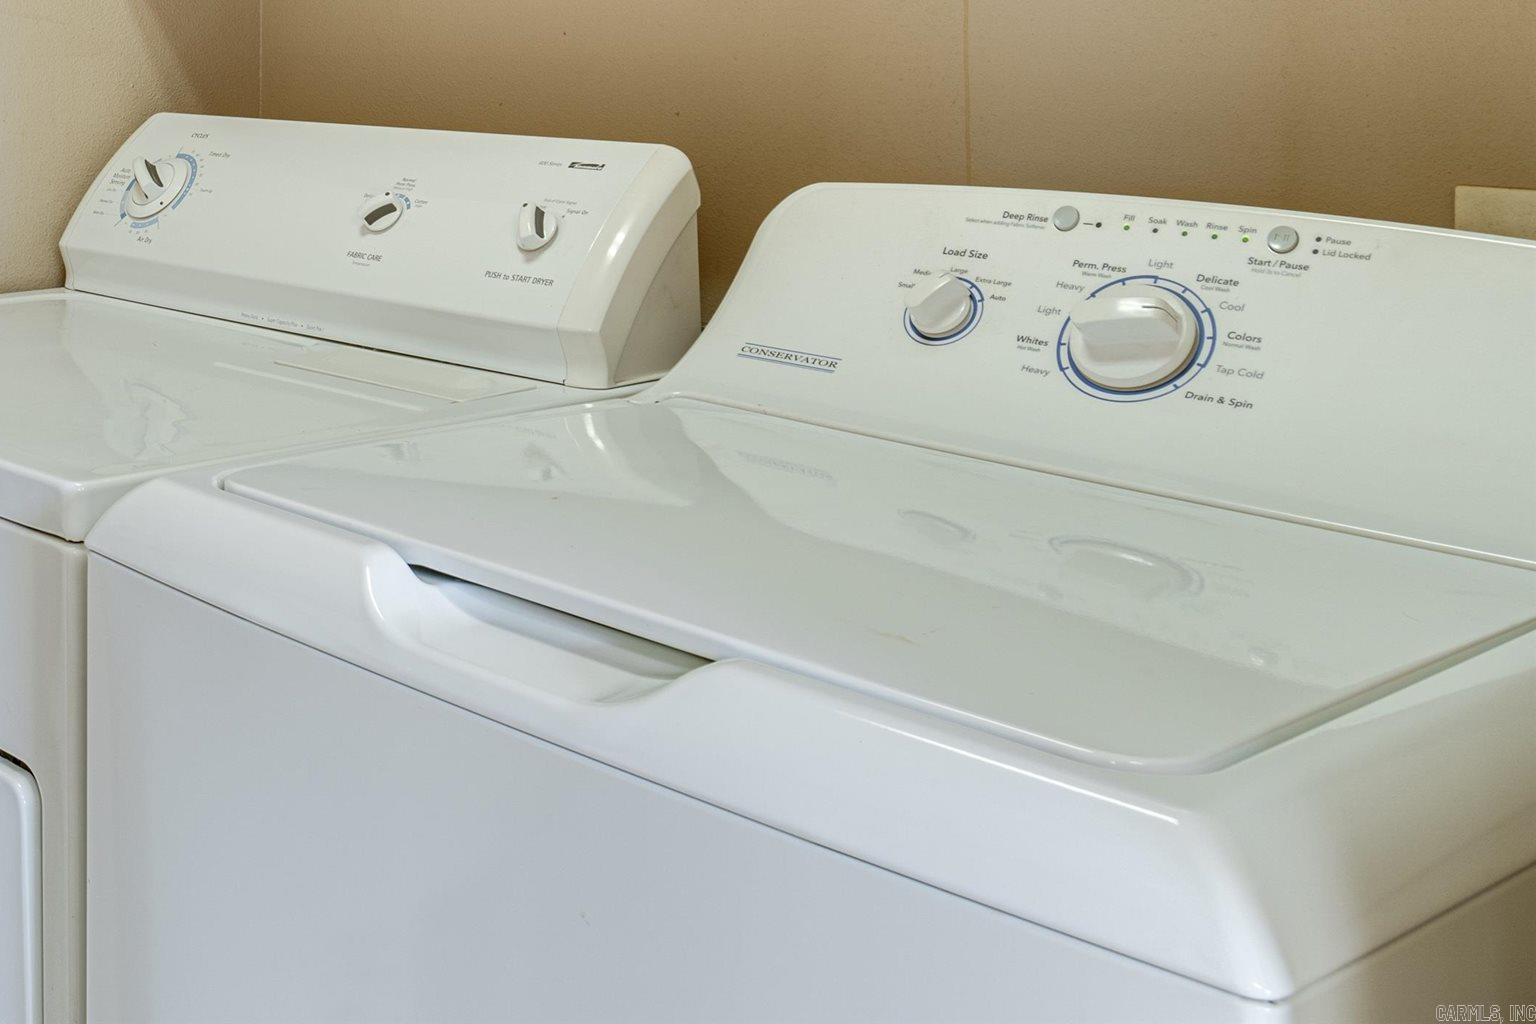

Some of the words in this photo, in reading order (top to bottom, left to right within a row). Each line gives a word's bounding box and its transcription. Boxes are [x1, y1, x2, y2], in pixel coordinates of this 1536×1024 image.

[1002, 210, 1024, 221] Deep
[1026, 213, 1049, 223] Rinse
[1123, 214, 1135, 222] Fill
[1148, 216, 1167, 225] Soak
[1176, 219, 1198, 228] Wash
[1206, 222, 1228, 231] Rinse
[1238, 225, 1257, 235] Spin
[1326, 236, 1352, 246] Pause
[367, 253, 383, 262] CARE
[943, 247, 966, 257] Load
[968, 249, 989, 260] Size
[1322, 249, 1336, 257] Lid
[1338, 250, 1372, 261] Locked
[1072, 259, 1099, 271] Perm.
[1101, 262, 1127, 274] Press
[1148, 258, 1174, 271] Light
[1247, 256, 1272, 267] Start
[1279, 260, 1310, 272] Pause
[484, 270, 502, 280] PUSH
[511, 274, 531, 283] START
[532, 277, 554, 286] DRYER
[975, 276, 992, 284] Extra
[993, 278, 1012, 287] Large
[1196, 273, 1240, 287] Delicate
[1056, 280, 1086, 293] Heavy
[989, 294, 1006, 302] Auto
[1037, 305, 1062, 316] Light
[1219, 301, 1246, 312] Cool
[1016, 334, 1049, 347] Whites
[1227, 331, 1262, 344] Colors
[741, 346, 838, 369] CONSERVATOR
[1020, 364, 1051, 377] Heavy
[1215, 364, 1235, 376] Tap
[1238, 367, 1265, 380] Cold
[1184, 390, 1214, 404] Drain
[1216, 396, 1225, 405] &
[1228, 397, 1253, 409] Spin
